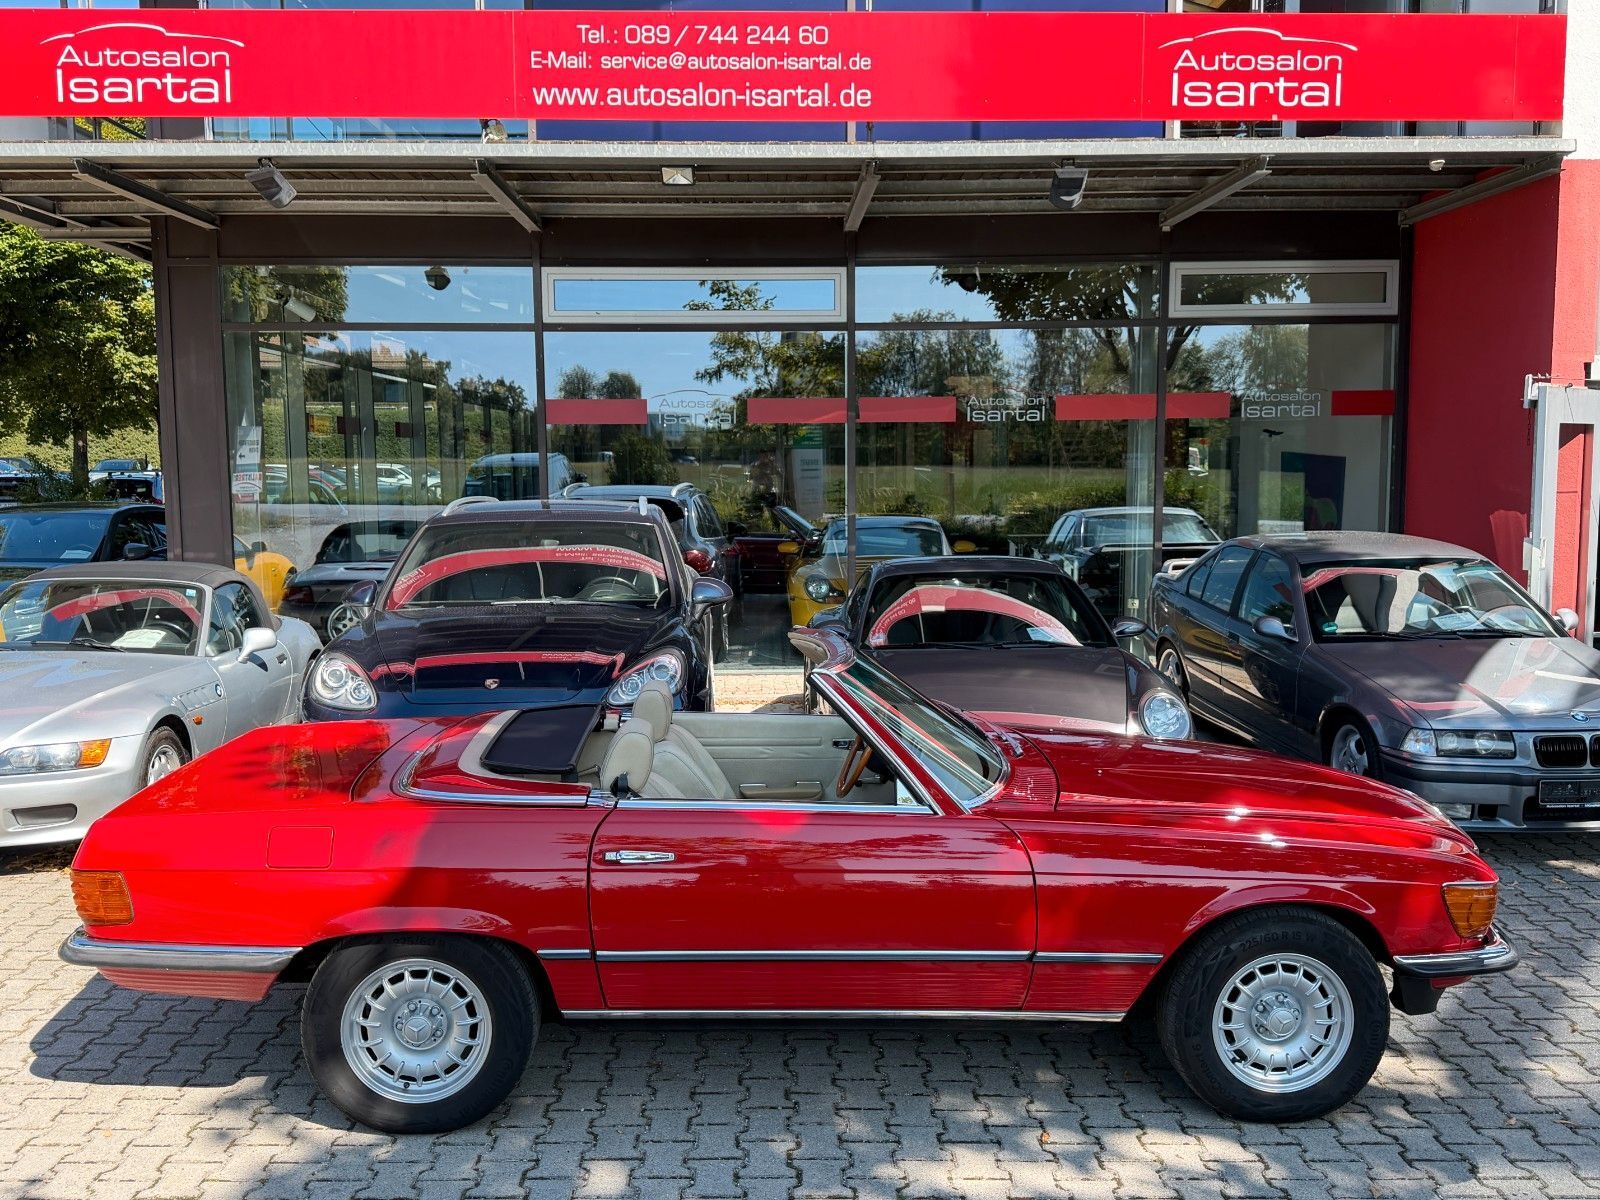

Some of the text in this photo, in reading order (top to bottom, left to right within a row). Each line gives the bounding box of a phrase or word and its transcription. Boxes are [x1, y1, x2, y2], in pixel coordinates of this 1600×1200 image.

[577, 25, 618, 44] Tel.:
[625, 25, 671, 44] 089
[695, 26, 739, 44] 744
[746, 26, 791, 44] 244
[799, 26, 829, 44] 60
[57, 45, 230, 67] Autosalon
[530, 51, 872, 71] E-Mail: service@autosalon-isartal.de
[1174, 50, 1342, 71] Autosalon
[56, 69, 232, 103] Isartal
[532, 82, 872, 107] www.autosalon-isartal.de
[1172, 73, 1341, 106] Isartal
[967, 396, 1045, 406] Autosalon
[1242, 392, 1320, 402] Autosalon
[967, 405, 1045, 422] Isartal
[1241, 401, 1320, 418] Isartal
